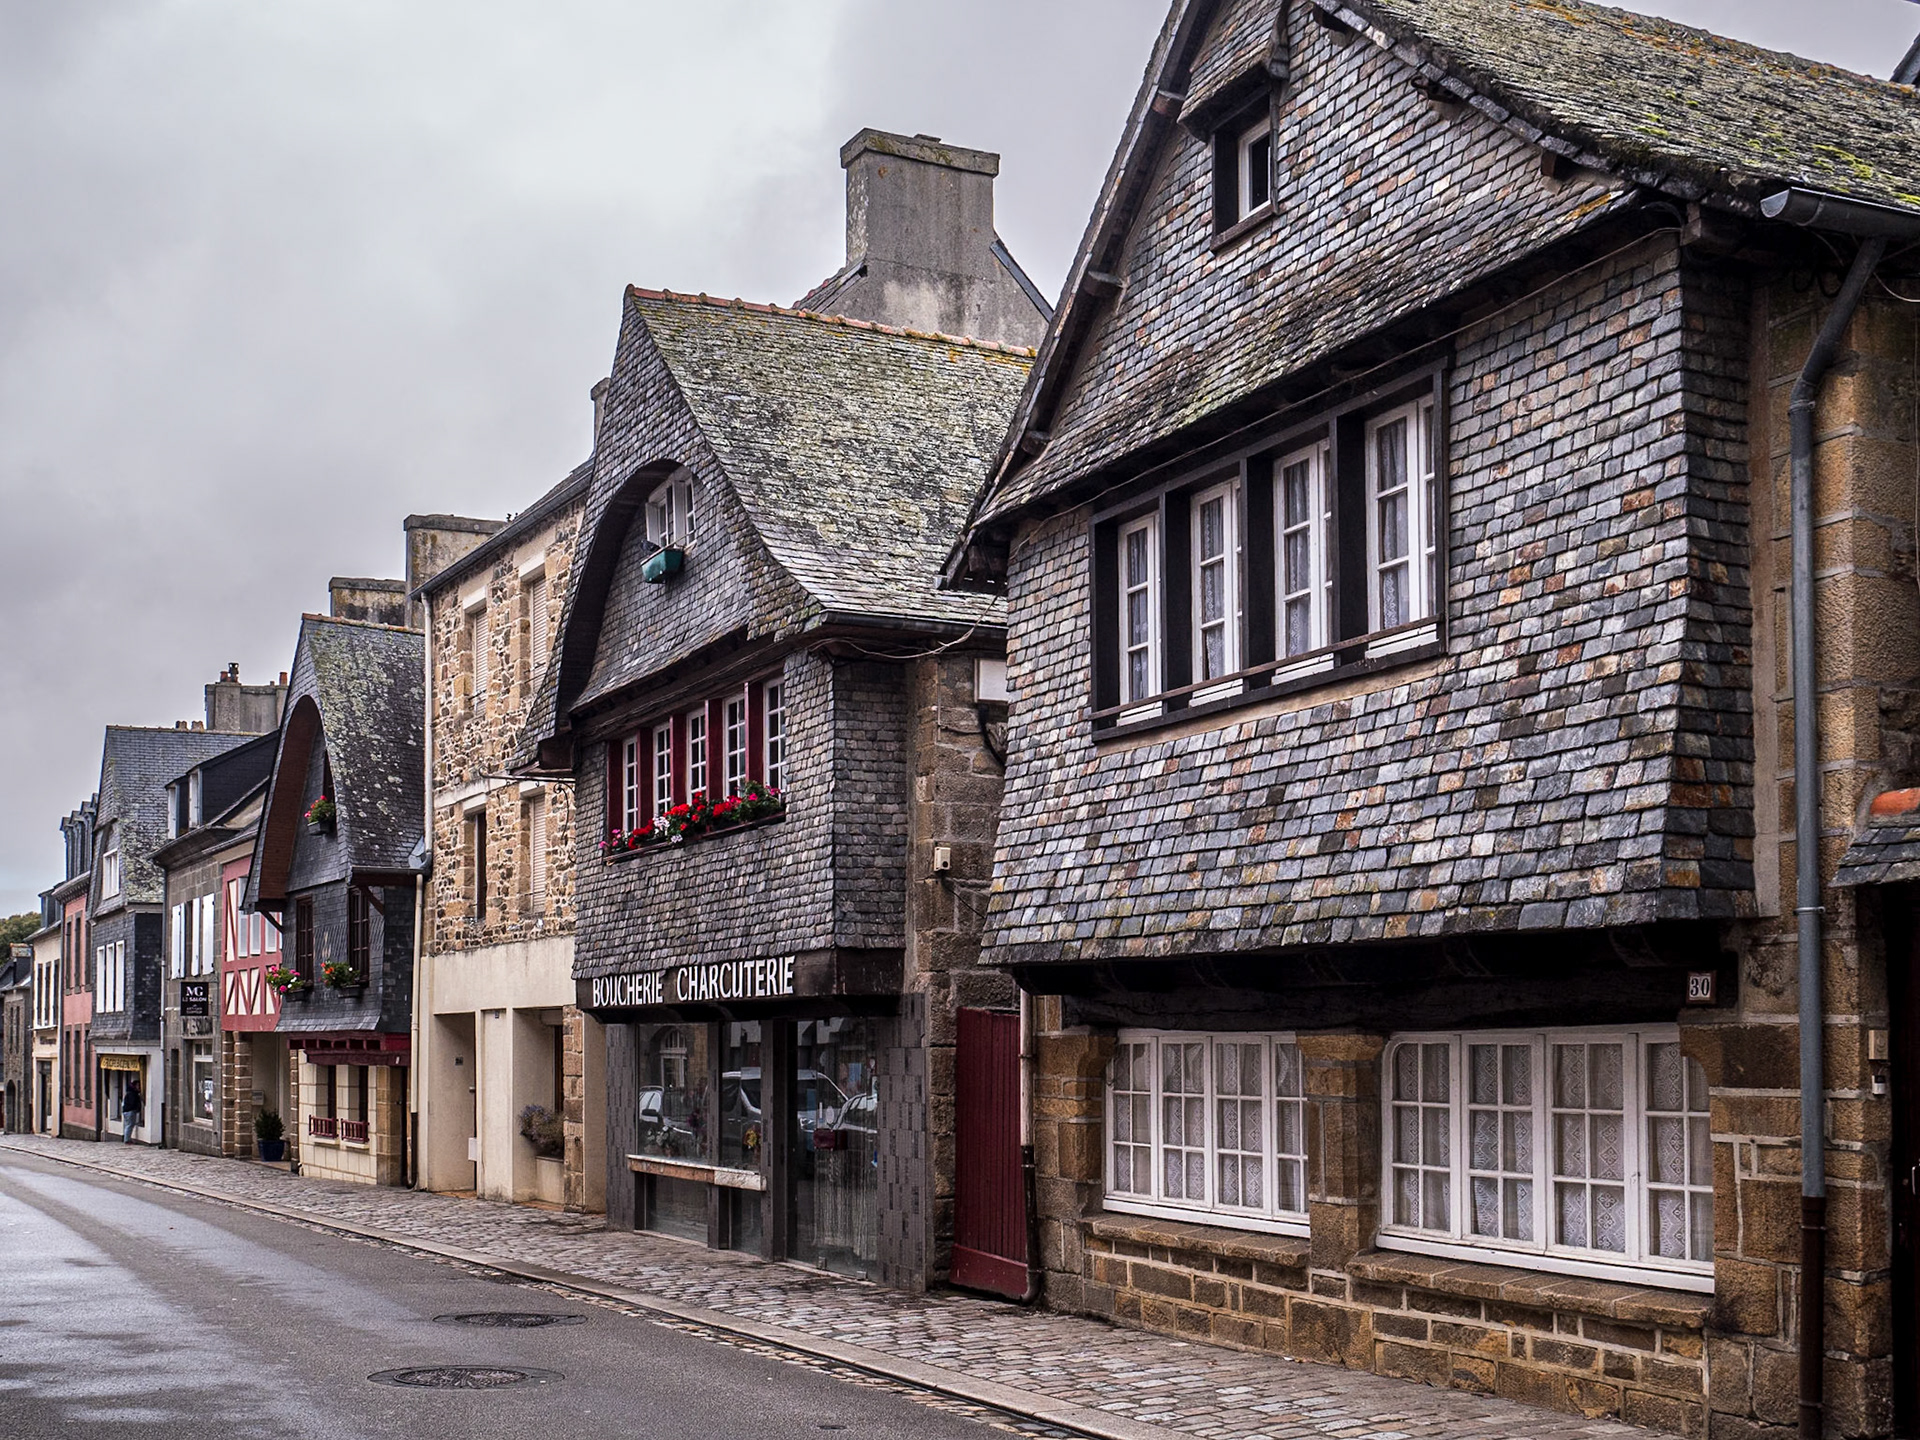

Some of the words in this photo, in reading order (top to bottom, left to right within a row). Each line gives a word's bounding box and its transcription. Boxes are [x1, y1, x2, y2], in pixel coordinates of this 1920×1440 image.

[593, 971, 664, 1007] BOUCHERIE
[677, 956, 795, 1001] CHARCUTERIE
[1690, 977, 1710, 996] 30
[186, 986, 204, 997] MG
